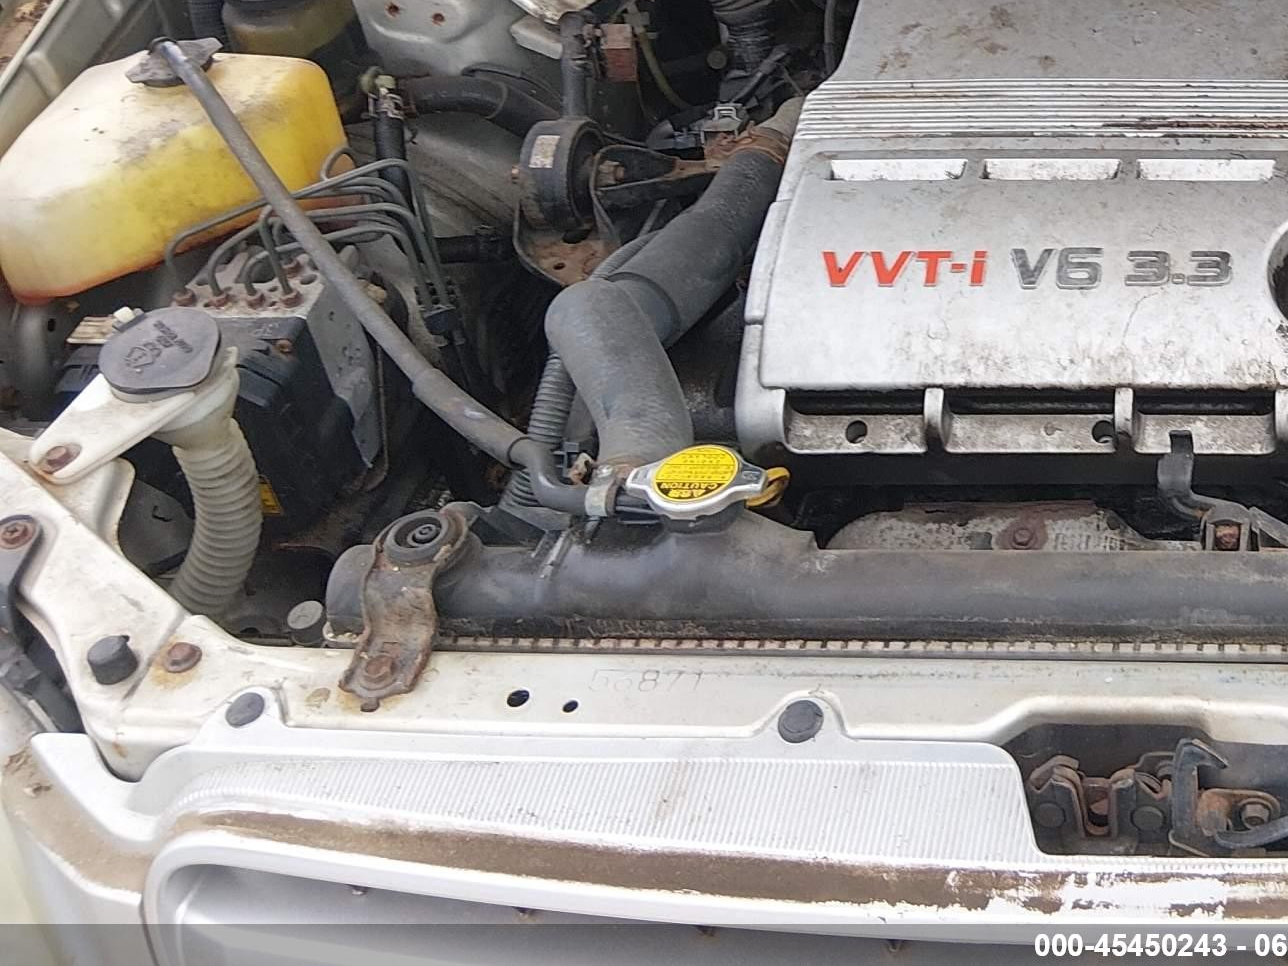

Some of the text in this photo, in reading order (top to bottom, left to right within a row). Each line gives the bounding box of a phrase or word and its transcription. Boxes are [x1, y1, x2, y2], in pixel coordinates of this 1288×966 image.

[822, 247, 1233, 290] VVT-i V6 3.3
